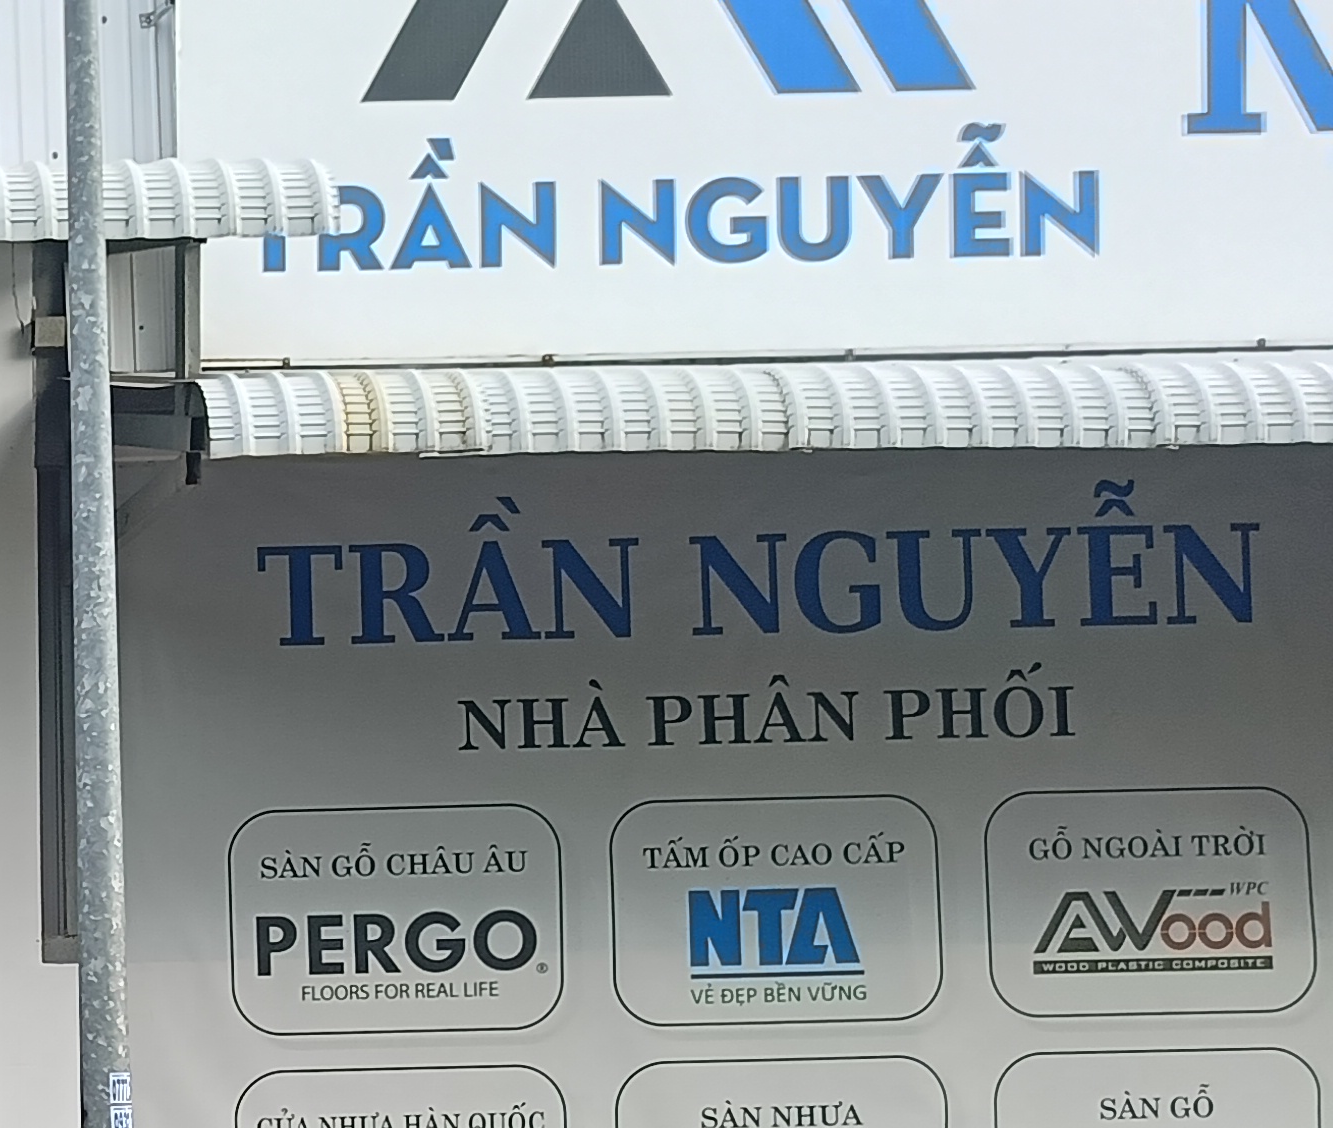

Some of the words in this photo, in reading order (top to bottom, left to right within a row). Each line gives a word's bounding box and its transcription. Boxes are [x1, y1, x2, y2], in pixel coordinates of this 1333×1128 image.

[599, 122, 1100, 266] NGUYỄN
[257, 496, 639, 646] TRẦN
[689, 479, 1260, 637] NGUYỄN
[457, 680, 626, 751] NHÀ
[648, 674, 860, 748] PHÂN
[885, 662, 1076, 742] PHỐI
[260, 850, 322, 879] SÀN
[332, 842, 376, 878] GỖ
[386, 846, 474, 876] CHÂU
[483, 844, 528, 874] ÂU
[643, 836, 709, 869] TẤM
[719, 835, 760, 868] ỐP
[771, 843, 832, 867] CAO
[843, 832, 905, 865] CẤP
[1028, 826, 1073, 861] GỖ
[1082, 829, 1184, 860] NGOÀI
[1191, 828, 1268, 857] TRỜI
[1228, 881, 1270, 897] WPC
[255, 909, 538, 977] PERGO
[688, 887, 861, 967] NTA
[1041, 961, 1090, 972] WOOD
[1097, 960, 1164, 971] PLASTIC
[1171, 958, 1266, 970] COMPOSITE
[301, 984, 371, 1002] FLOORS
[374, 983, 411, 1001] FOR
[414, 982, 460, 1000] REAL
[463, 981, 500, 998] LIFE
[690, 983, 715, 1005] VẺ
[720, 987, 757, 1007] ĐẸP
[764, 981, 801, 1004] BỀN
[807, 982, 868, 1003] VỮNG
[1099, 1090, 1160, 1121] SÀN
[1170, 1084, 1215, 1119] GỖ
